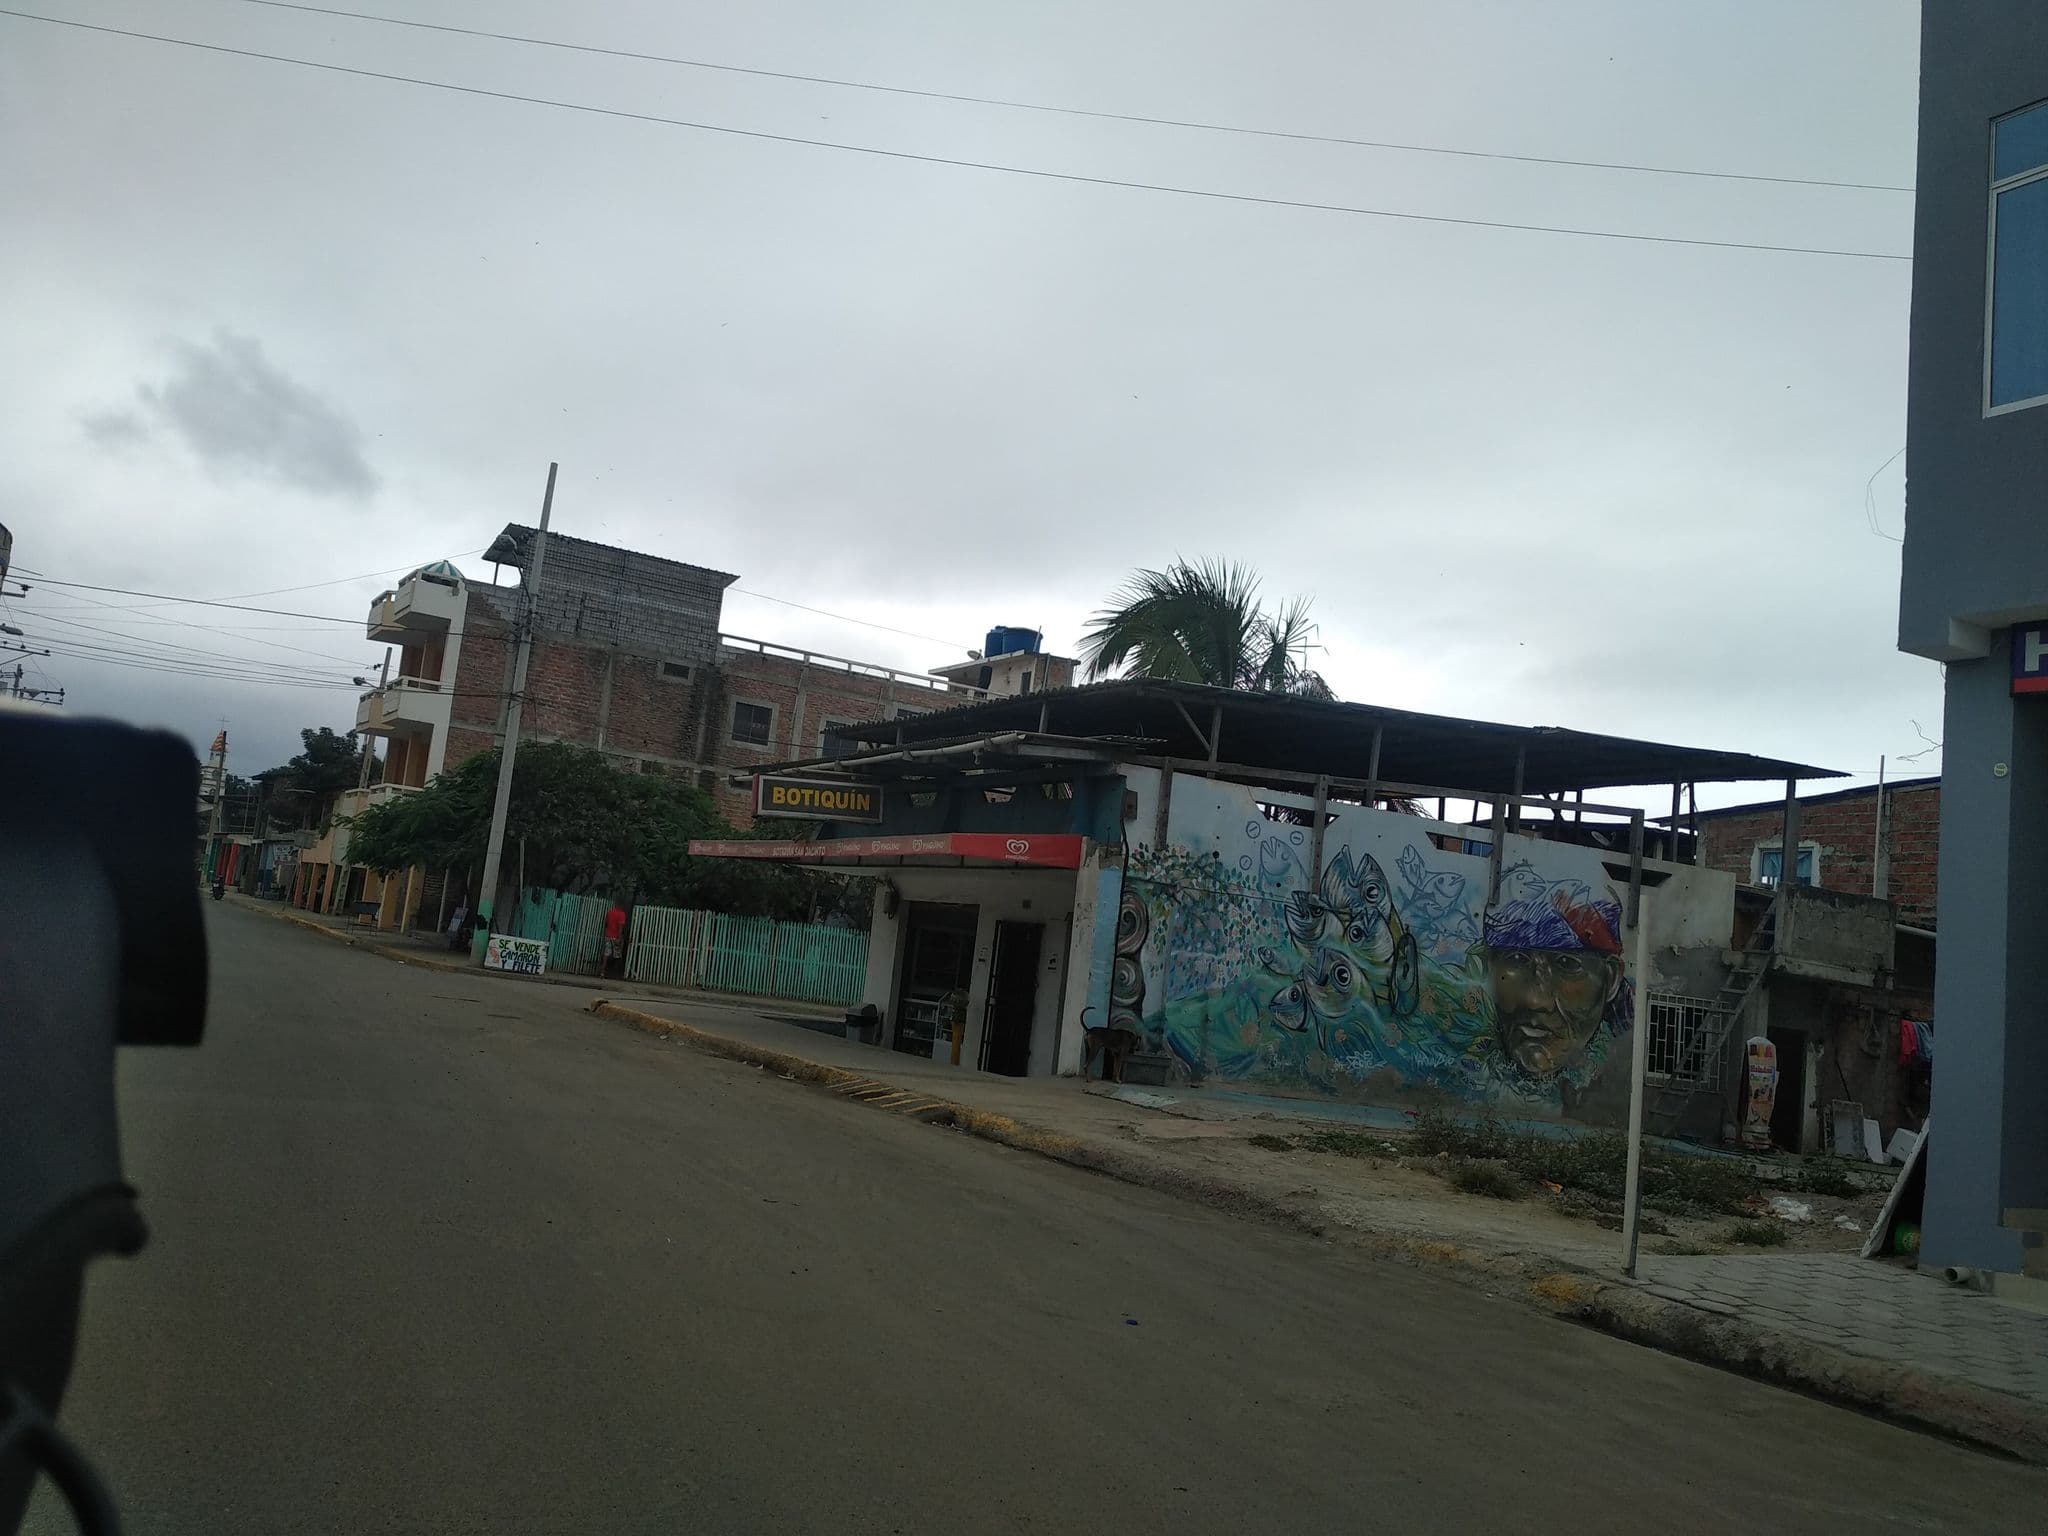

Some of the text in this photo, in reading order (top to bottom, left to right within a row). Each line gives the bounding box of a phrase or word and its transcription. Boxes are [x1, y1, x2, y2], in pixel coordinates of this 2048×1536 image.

[772, 786, 871, 811] BOTIQUÍN
[499, 939, 541, 955] SE VENDE
[500, 950, 540, 964] CAMARON
[502, 960, 542, 975] Y FILETE
